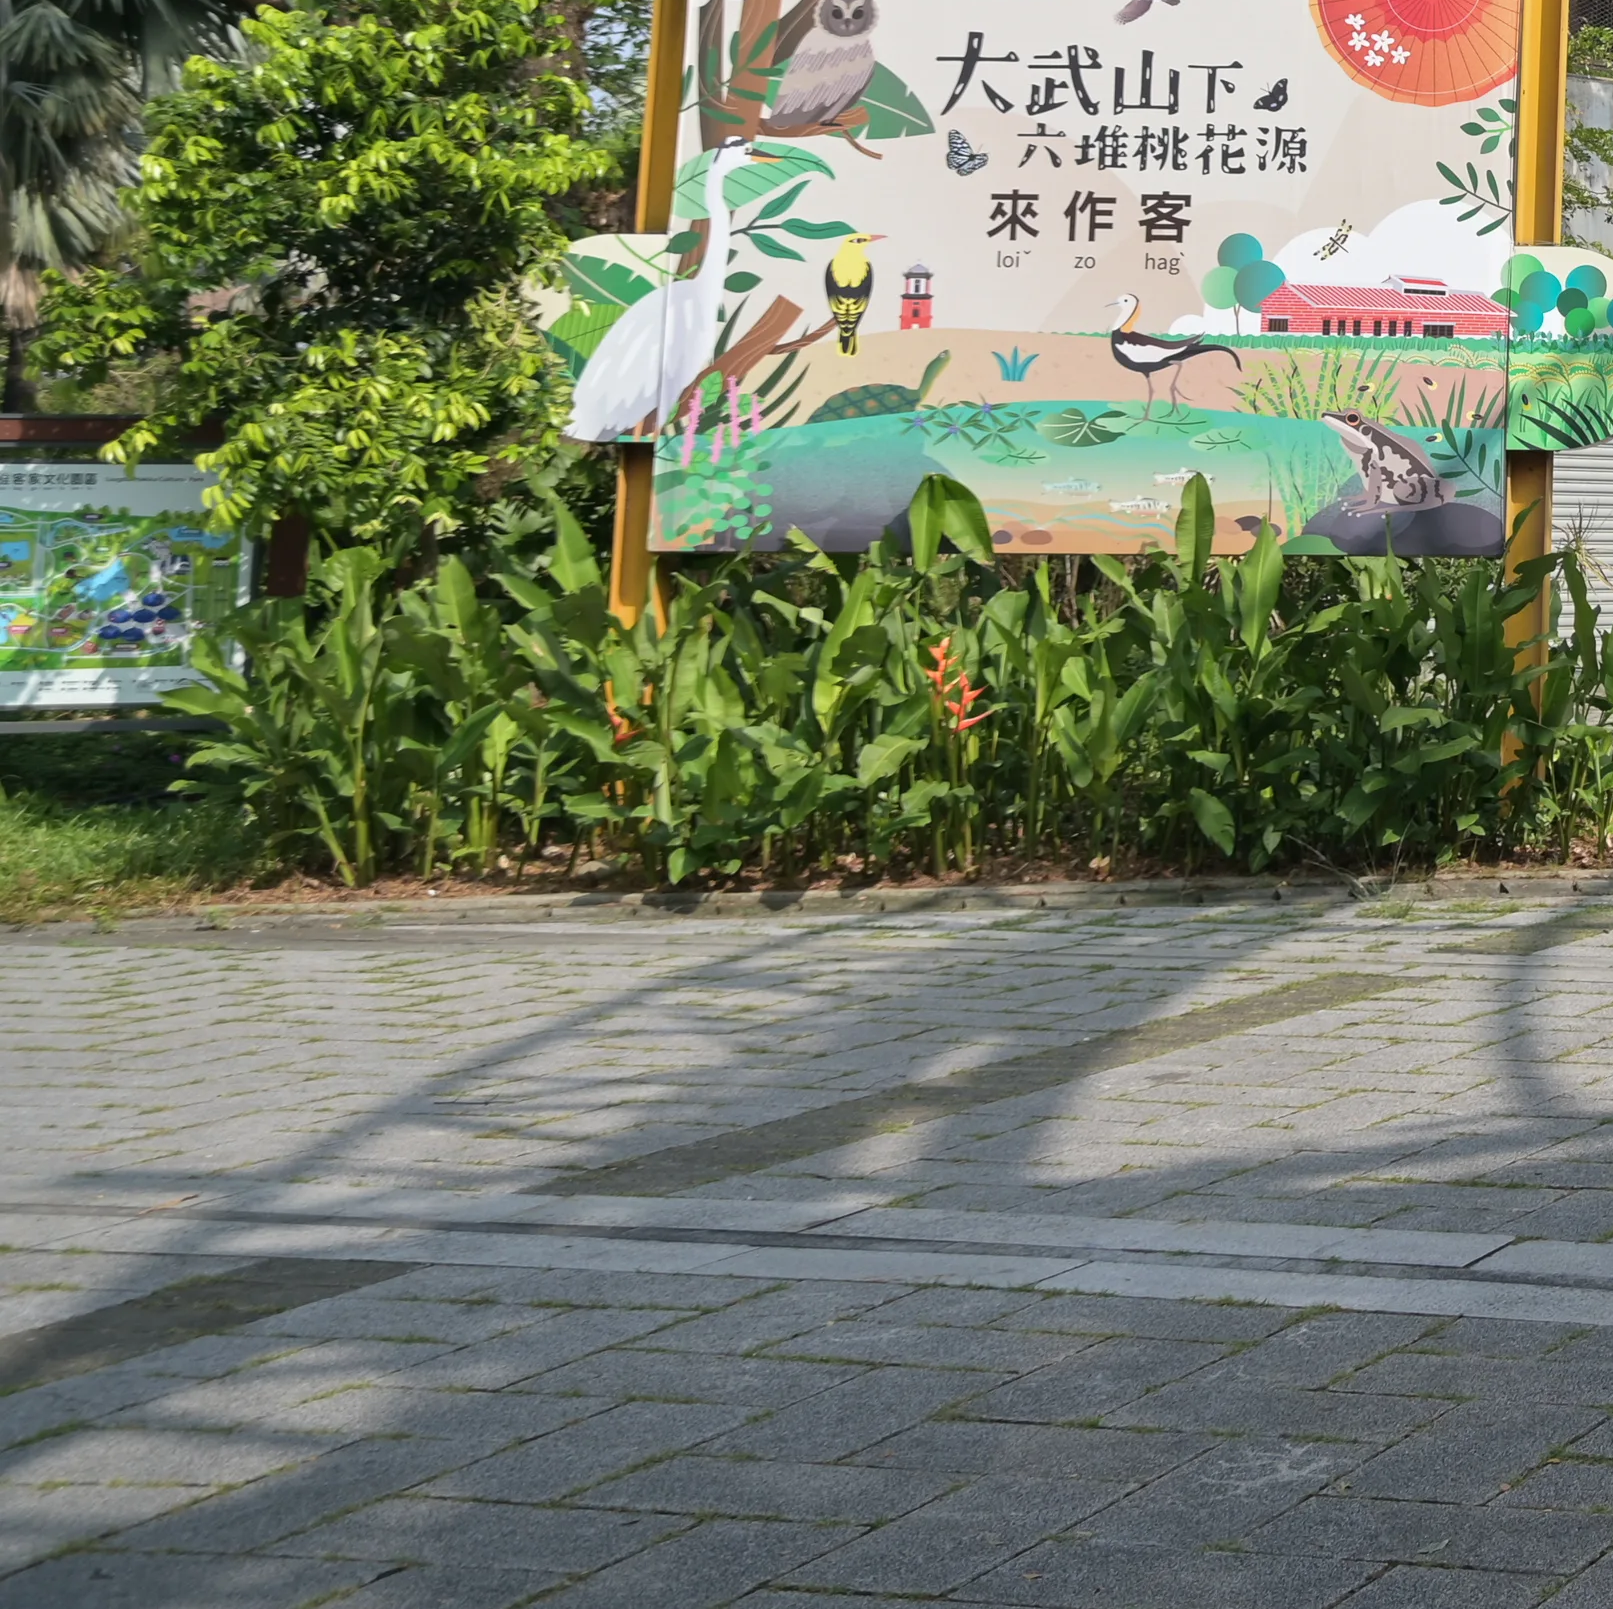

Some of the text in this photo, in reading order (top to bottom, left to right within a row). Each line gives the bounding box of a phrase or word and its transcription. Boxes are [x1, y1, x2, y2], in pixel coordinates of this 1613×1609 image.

[936, 31, 1244, 117] 大武山下
[1017, 122, 1308, 176] 六堆桃花源
[986, 188, 1193, 244] 來作客
[1073, 255, 1097, 269] zo
